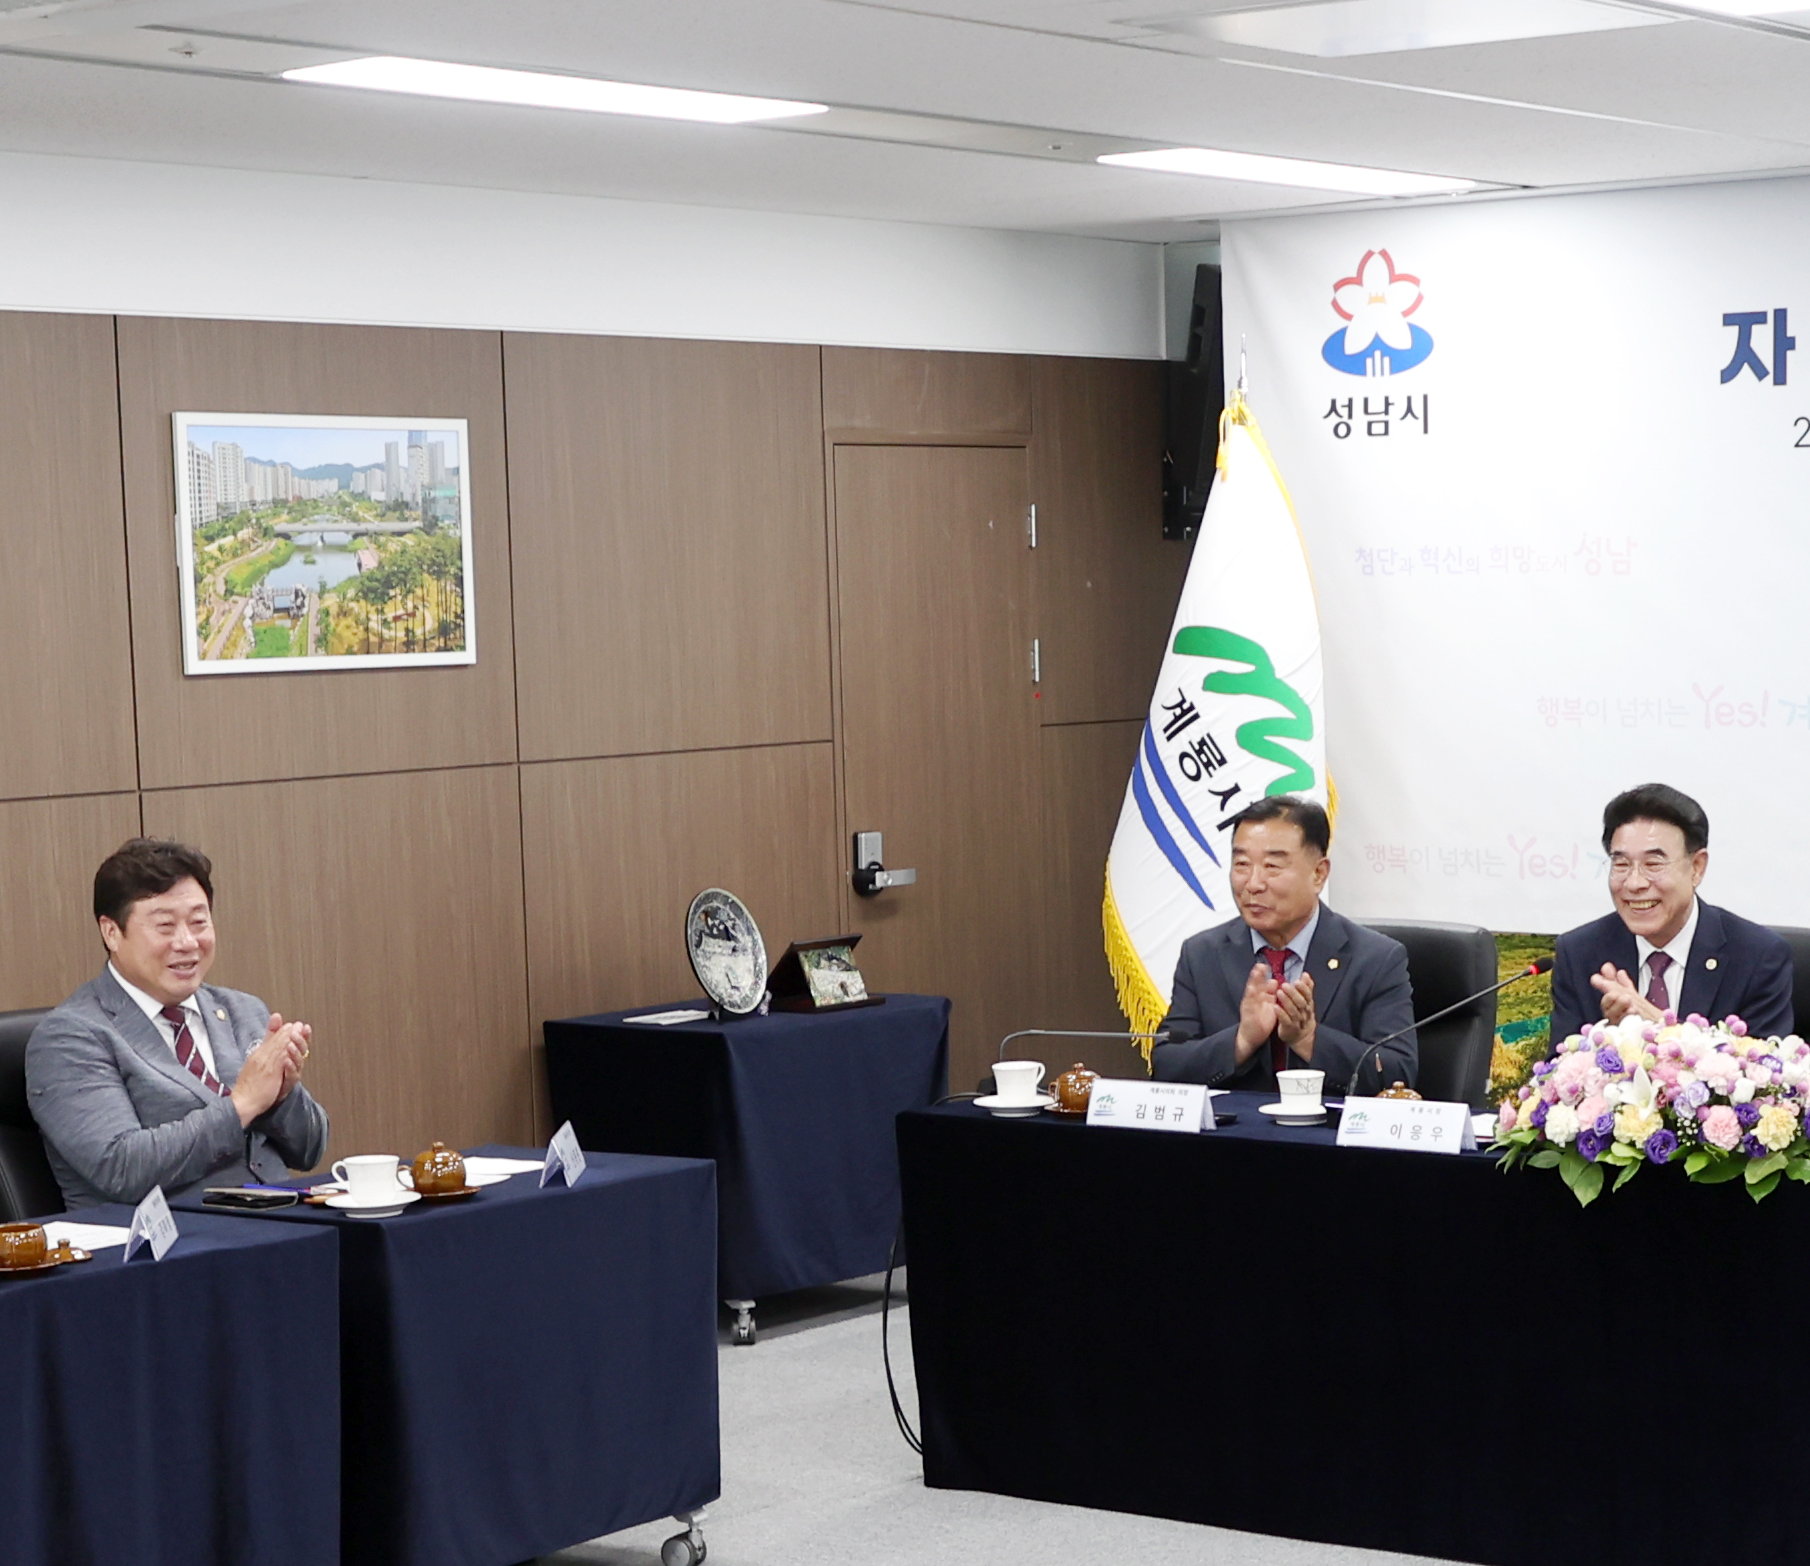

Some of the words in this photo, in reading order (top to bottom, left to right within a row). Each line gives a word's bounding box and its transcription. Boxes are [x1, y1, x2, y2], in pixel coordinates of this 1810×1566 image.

[1321, 393, 1431, 441] 성남시
[1354, 544, 1415, 577] 첨단과
[1419, 544, 1481, 576] 혁신의
[1488, 544, 1568, 575] 희망도시
[1573, 530, 1639, 577] 성남
[1536, 695, 1608, 729] 행복이
[1617, 696, 1690, 729] 넘치는
[1692, 681, 1770, 730] Yes!
[1161, 686, 1242, 832] 계룡시
[1364, 842, 1430, 875] 행복이
[1439, 845, 1506, 877] 넘치는
[1506, 833, 1580, 881] Yes!
[1135, 1103, 1185, 1122] 김범규
[1390, 1123, 1443, 1142] 이응우
